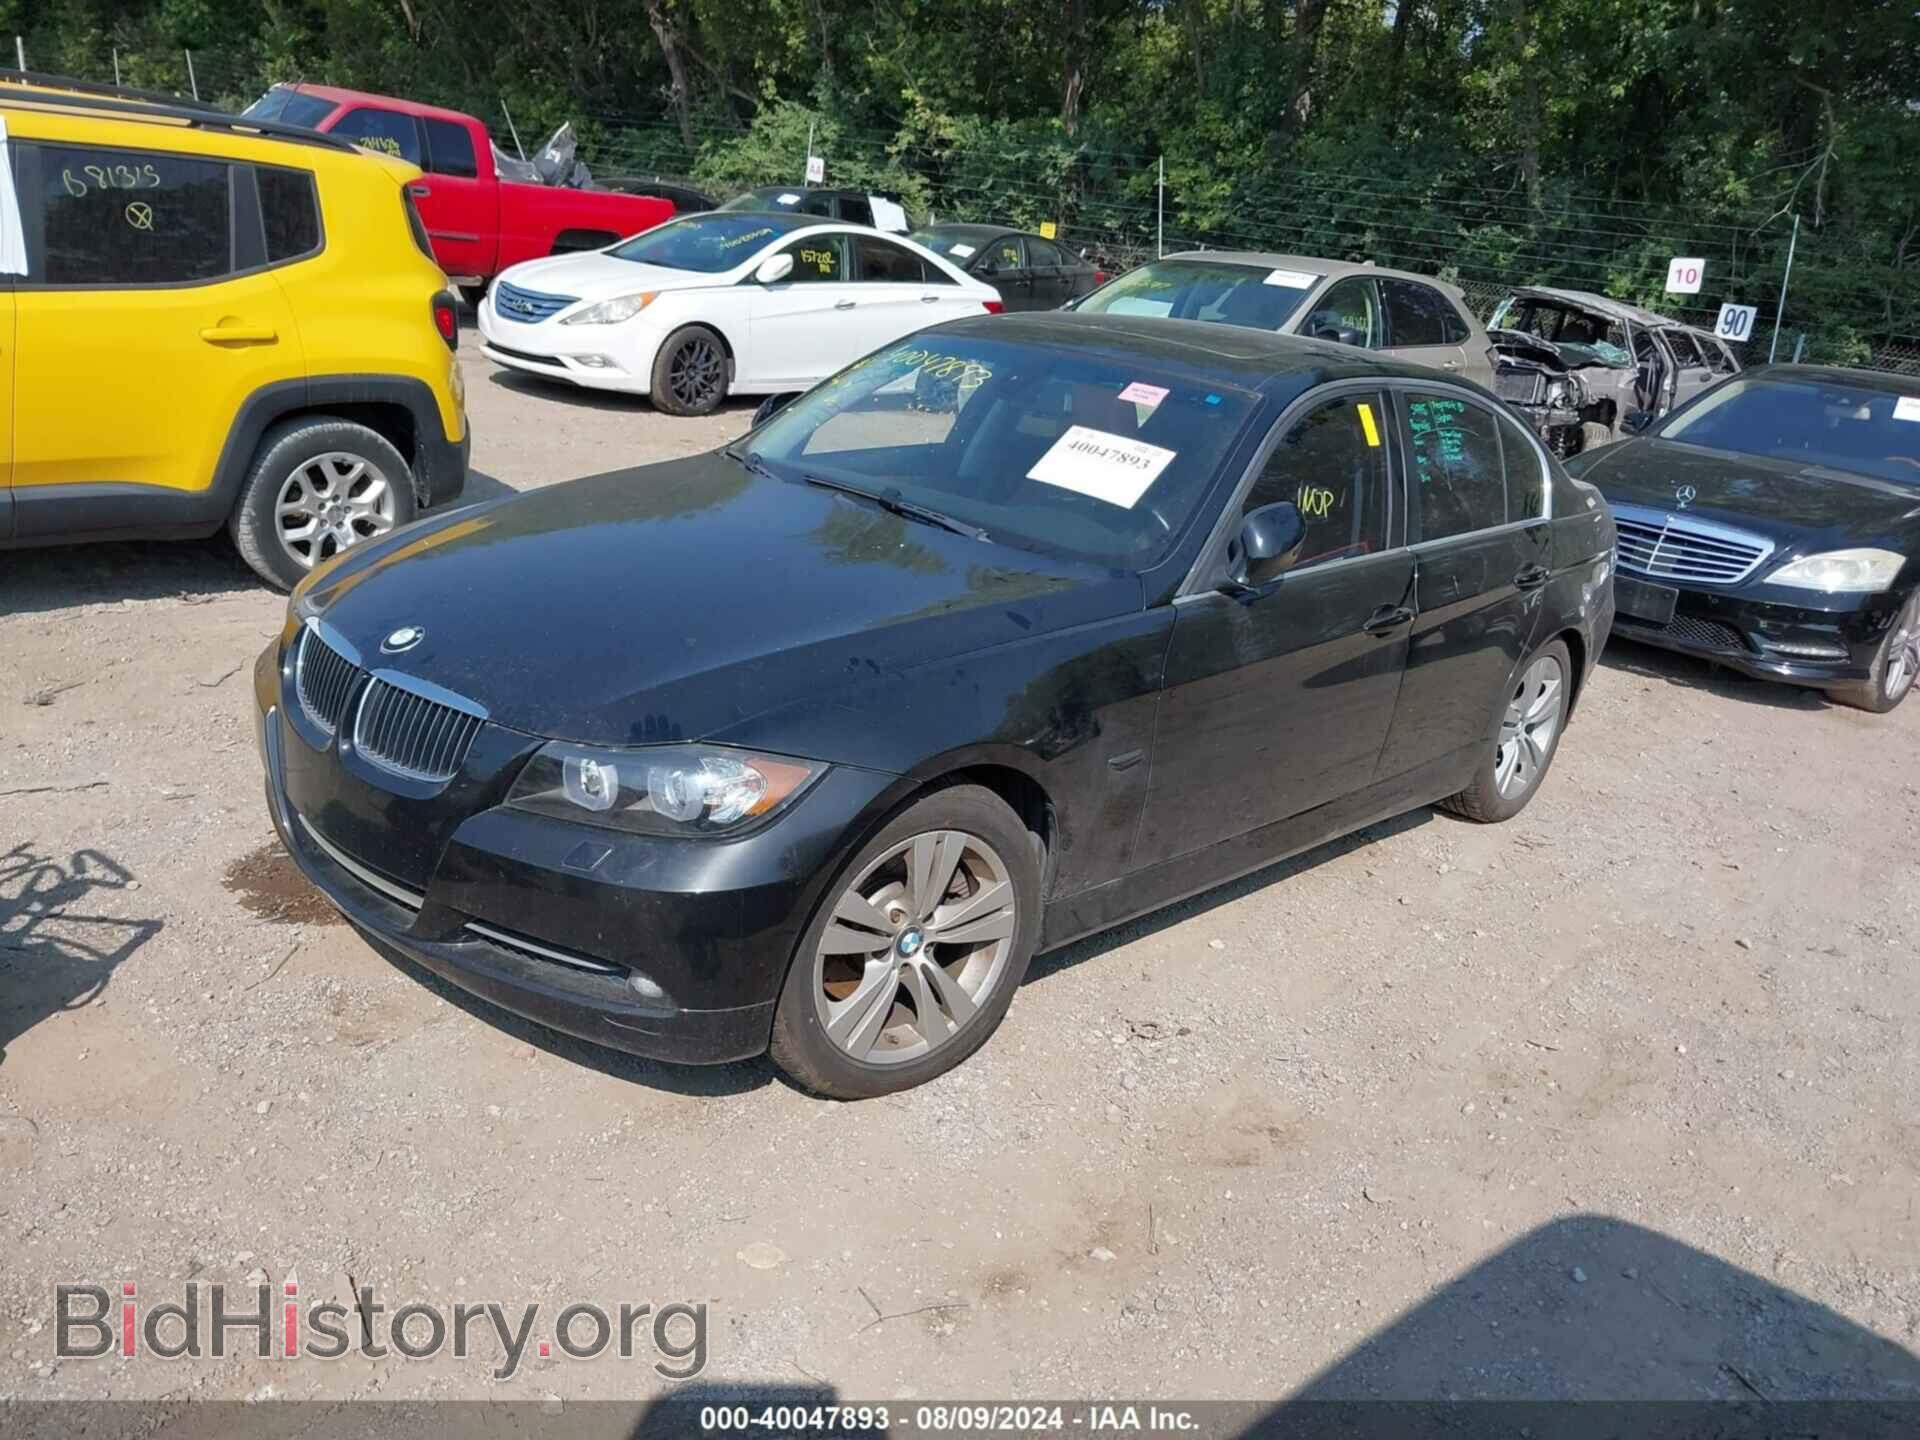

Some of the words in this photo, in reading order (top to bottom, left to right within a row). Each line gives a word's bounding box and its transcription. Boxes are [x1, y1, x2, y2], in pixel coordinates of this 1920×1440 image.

[1675, 268, 1697, 285] 10
[1721, 308, 1748, 336] 90
[1067, 439, 1152, 470] 40047893
